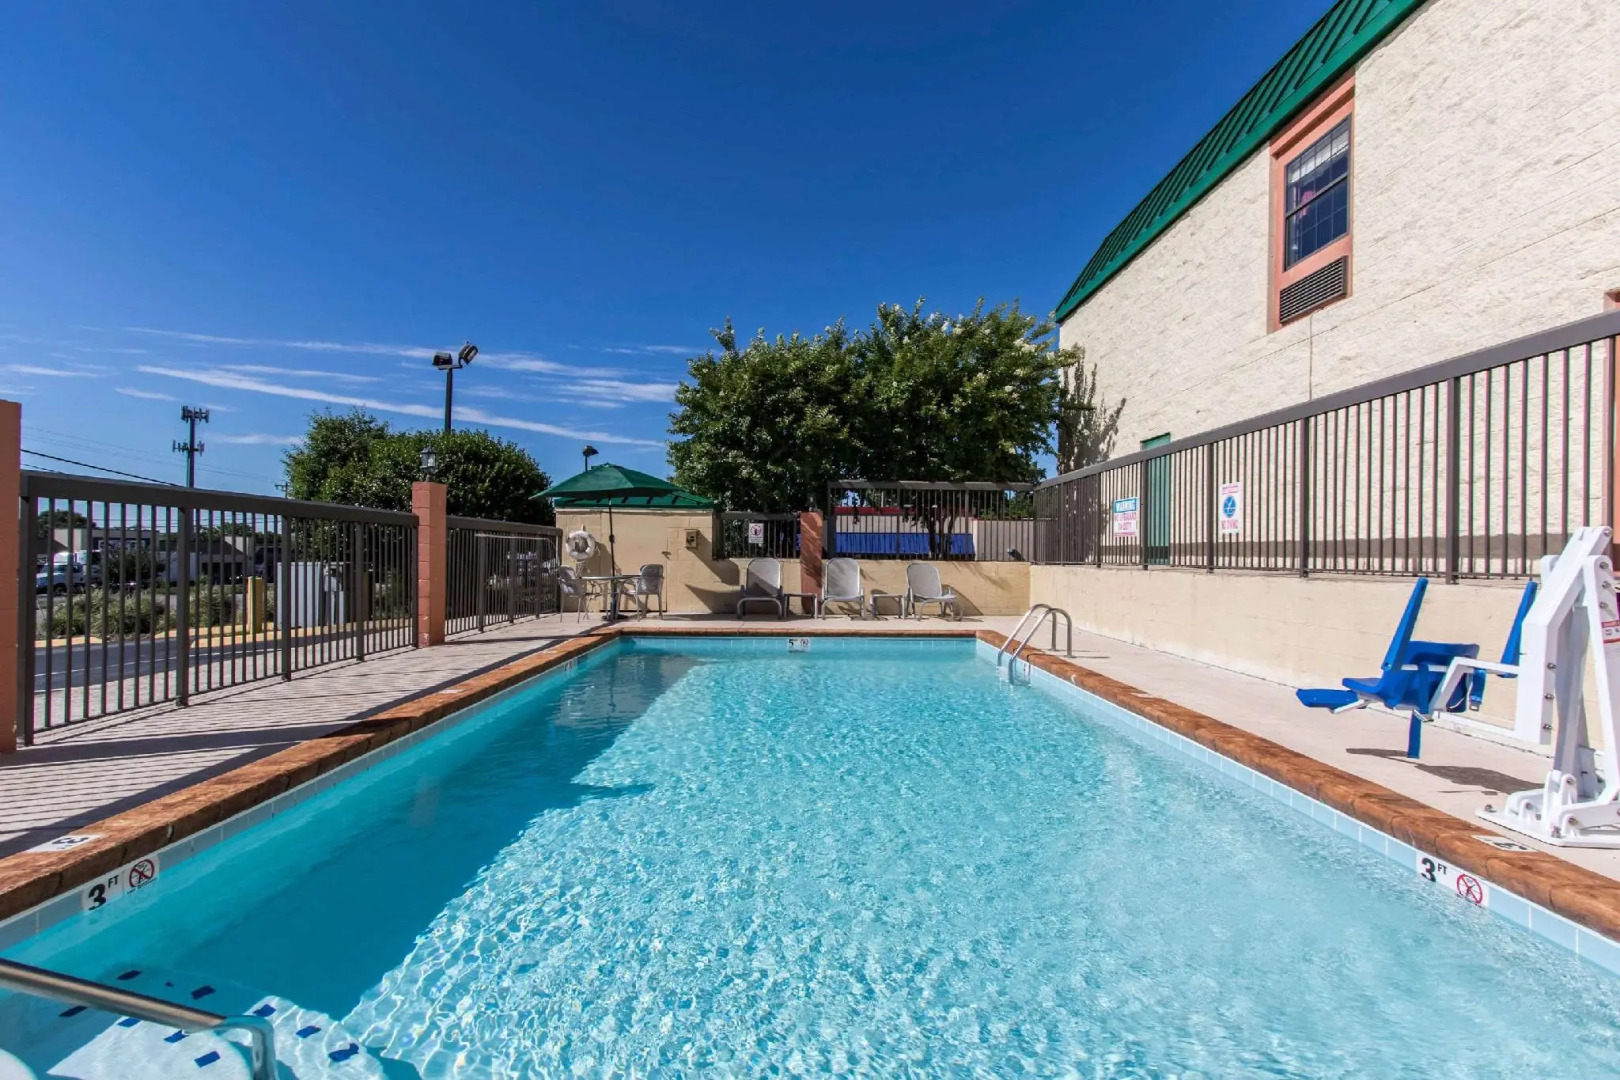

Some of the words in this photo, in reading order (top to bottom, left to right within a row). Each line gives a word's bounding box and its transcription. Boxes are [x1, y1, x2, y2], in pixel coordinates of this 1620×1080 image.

[1421, 857, 1437, 883] 3
[1437, 862, 1448, 876] FT
[88, 883, 107, 912] 3
[108, 874, 120, 889] FT
